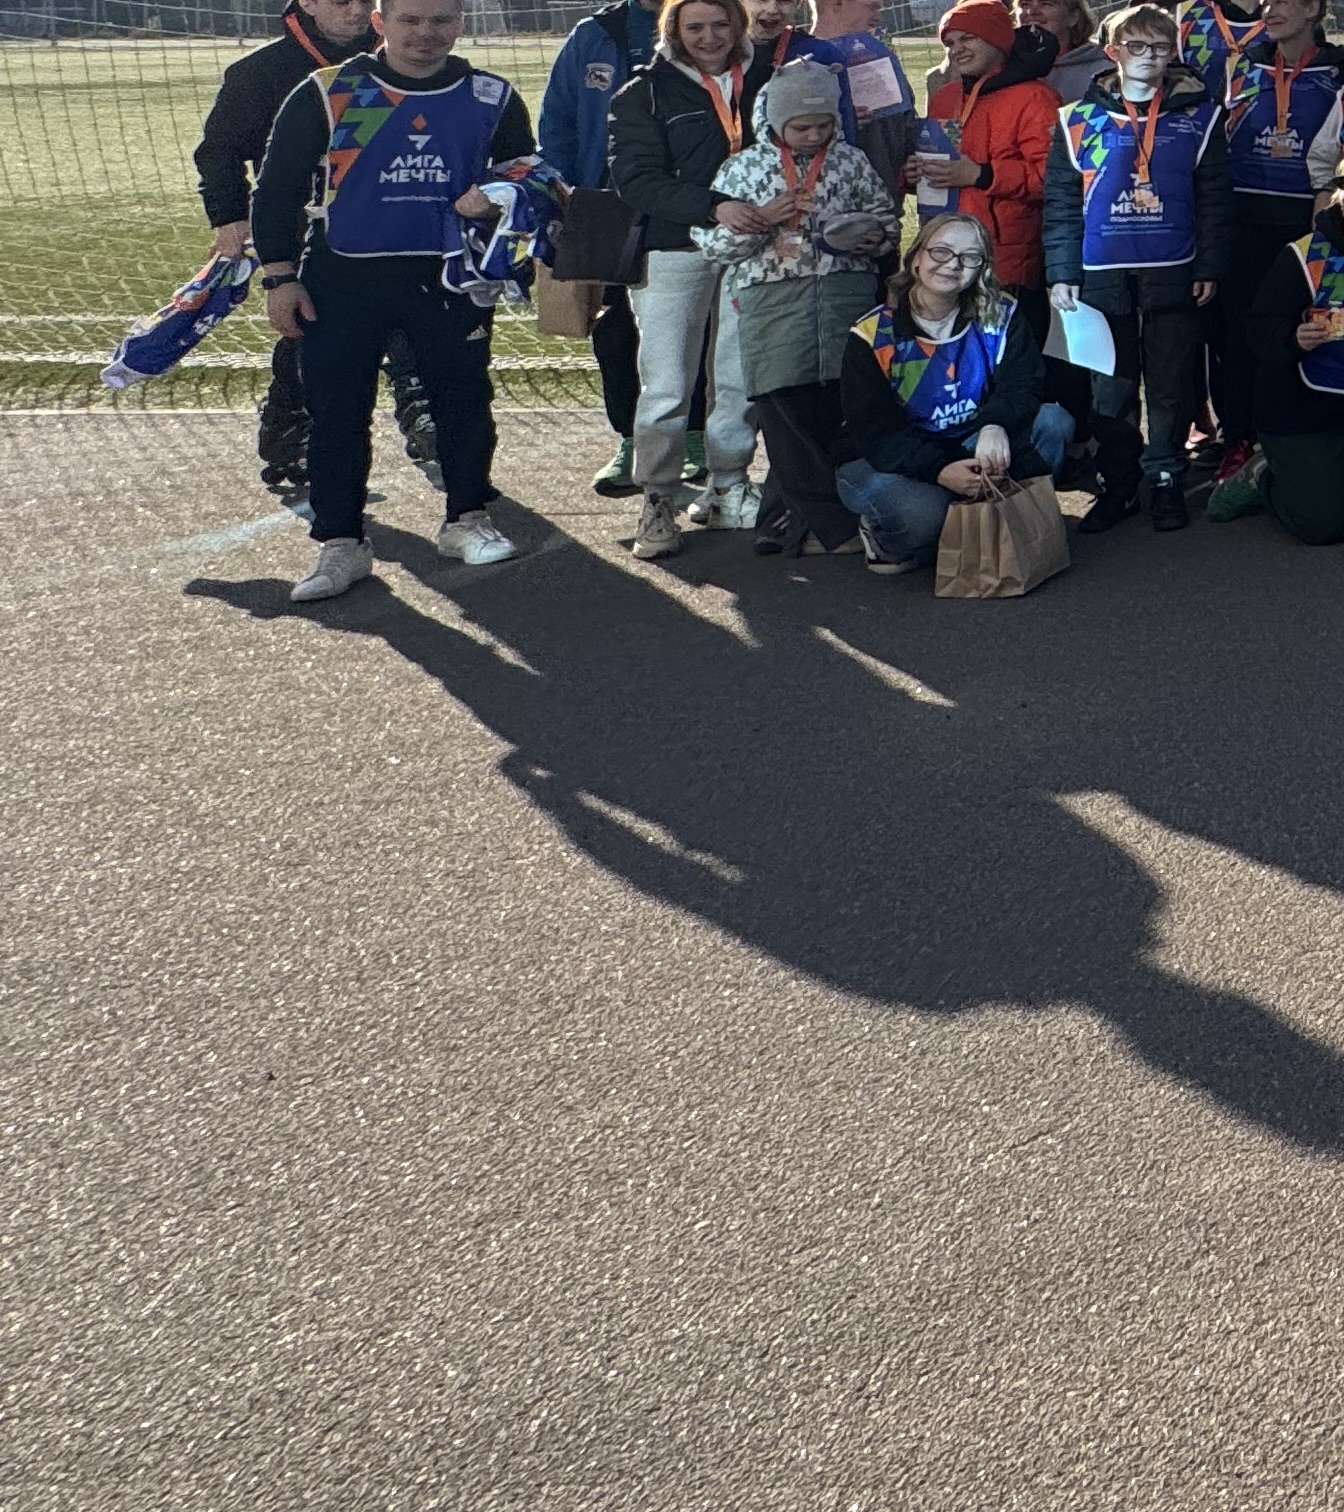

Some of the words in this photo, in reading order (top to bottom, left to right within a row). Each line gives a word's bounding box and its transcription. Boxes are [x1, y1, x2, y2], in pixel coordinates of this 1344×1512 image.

[389, 154, 446, 169] ЛИГА
[378, 169, 452, 184] МЕЧТЫ
[930, 398, 979, 421] ЛИГА
